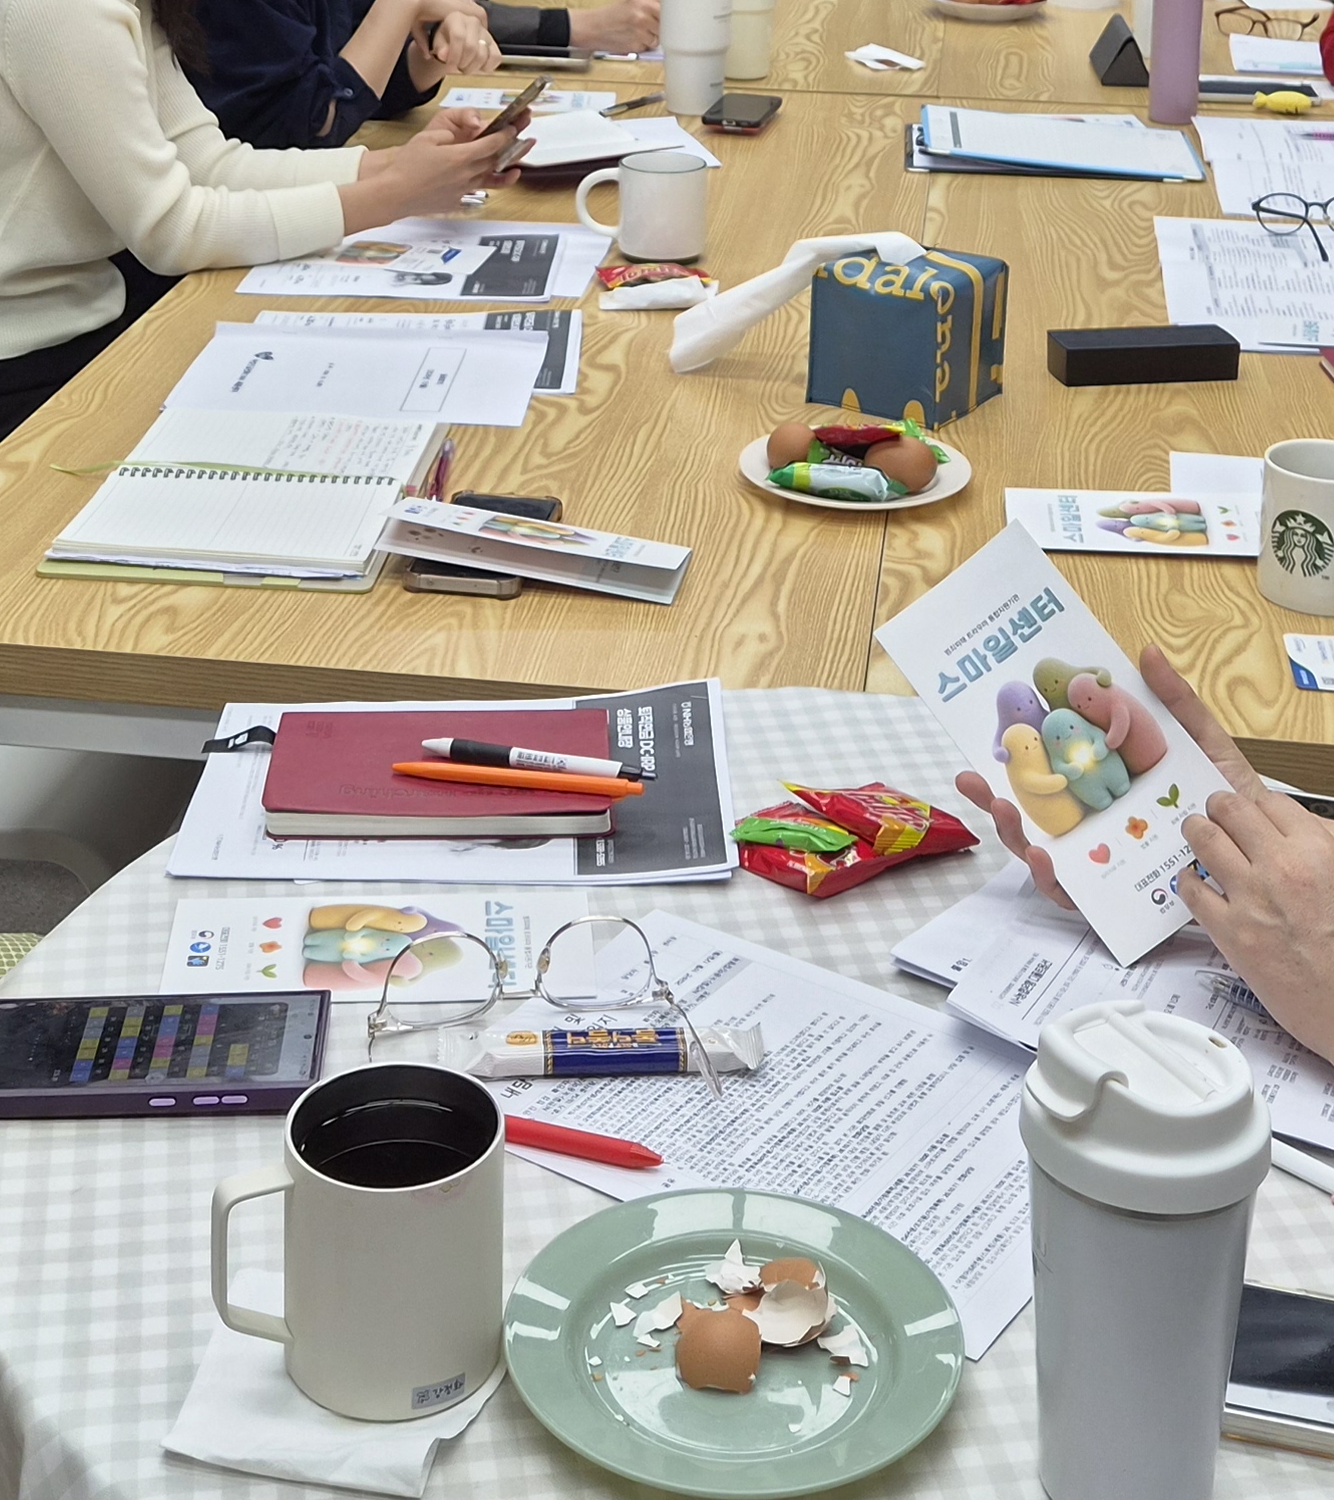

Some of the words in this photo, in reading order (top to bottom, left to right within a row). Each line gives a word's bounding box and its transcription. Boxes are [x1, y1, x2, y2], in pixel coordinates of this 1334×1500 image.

[926, 586, 1067, 705] 스마일센터
[617, 708, 634, 749] 상품안내장
[638, 706, 655, 740] 퇴직연금
[1133, 867, 1161, 892] 대표전화
